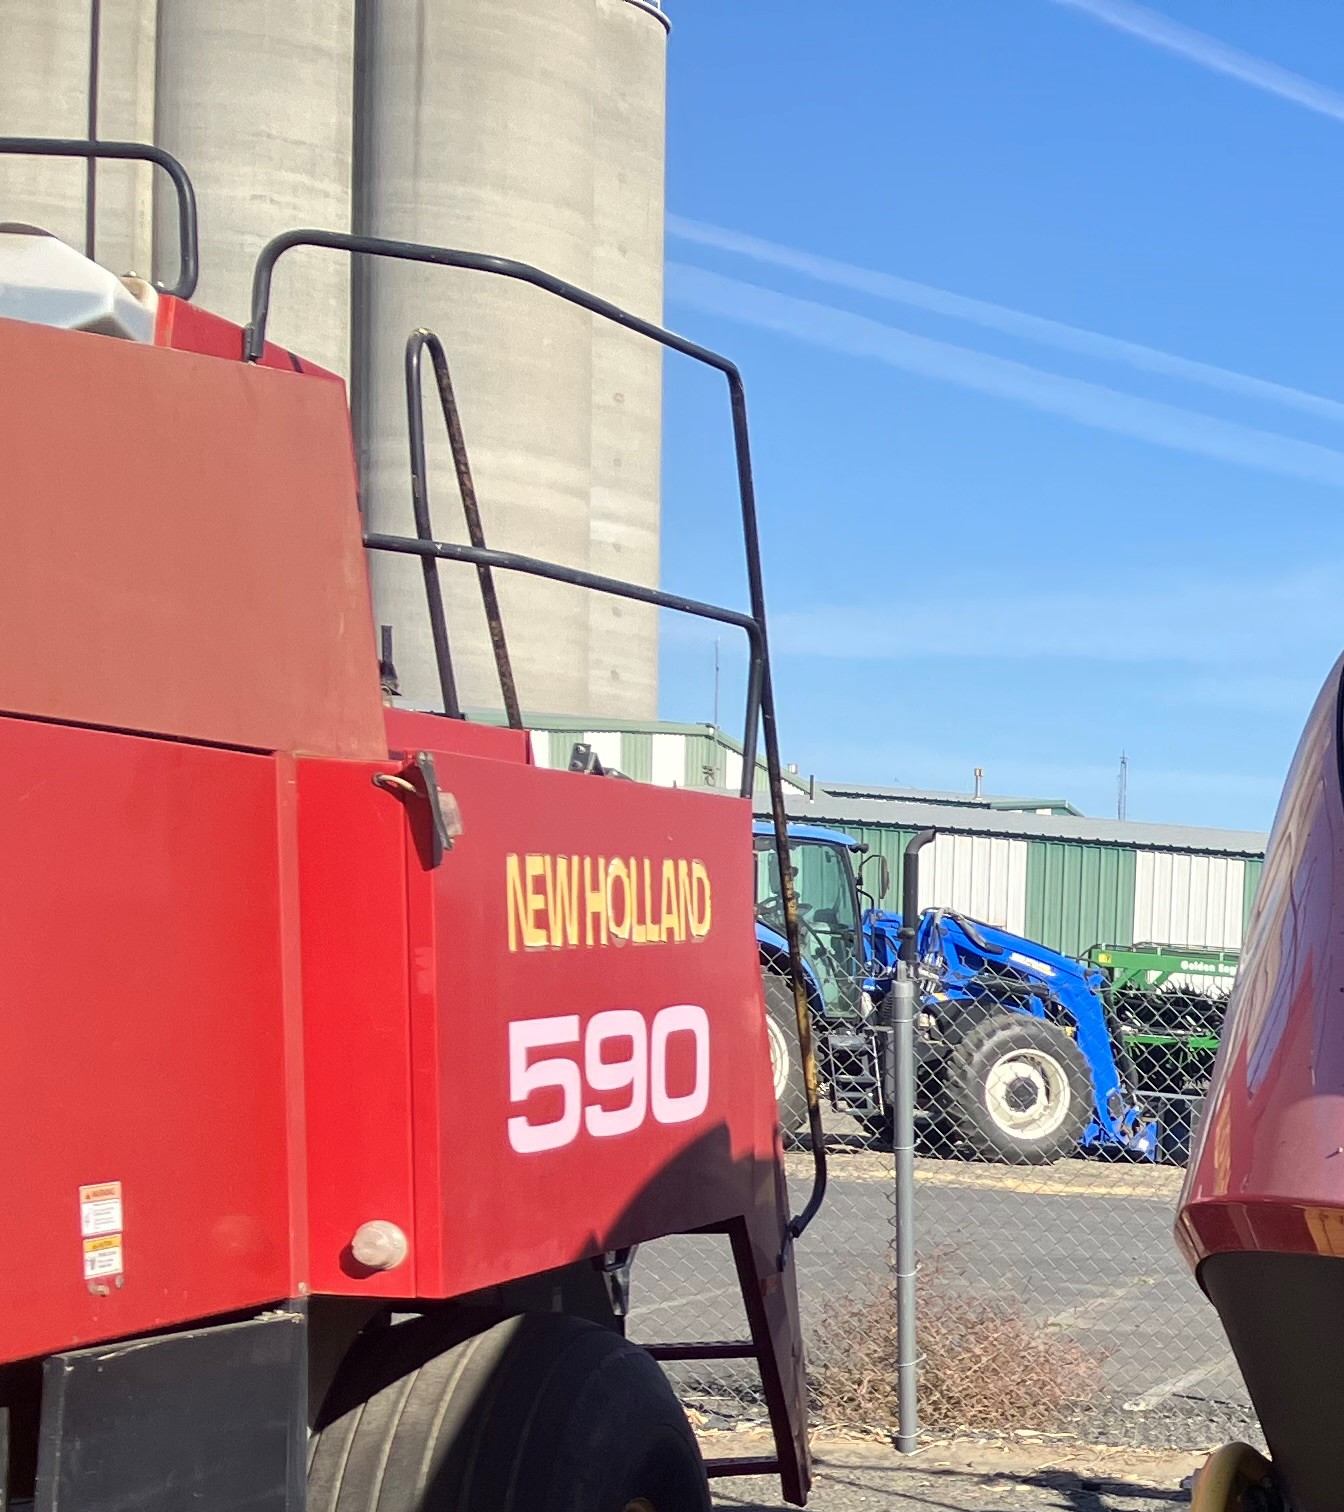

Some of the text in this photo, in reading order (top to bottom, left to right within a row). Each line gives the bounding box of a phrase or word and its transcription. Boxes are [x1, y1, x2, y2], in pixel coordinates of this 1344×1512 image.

[506, 853, 712, 951] NEW HOLLAND
[1218, 963, 1238, 976] Eag
[508, 1005, 710, 1154] 590
